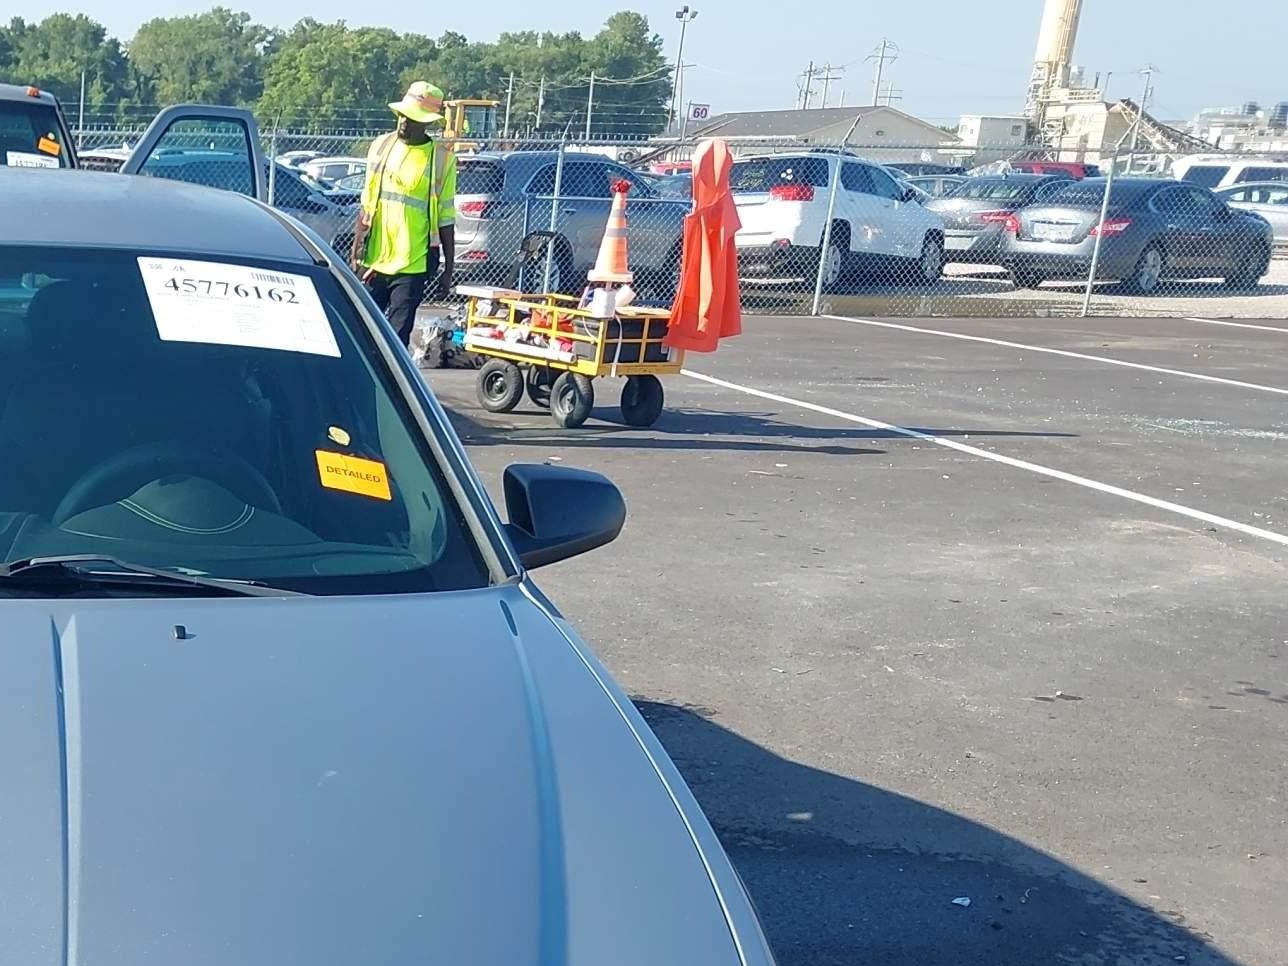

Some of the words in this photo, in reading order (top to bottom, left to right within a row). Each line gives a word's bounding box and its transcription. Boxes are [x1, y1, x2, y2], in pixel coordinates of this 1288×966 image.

[693, 106, 708, 119] 60
[164, 277, 300, 305] 45776162
[325, 464, 382, 484] DETAILED
